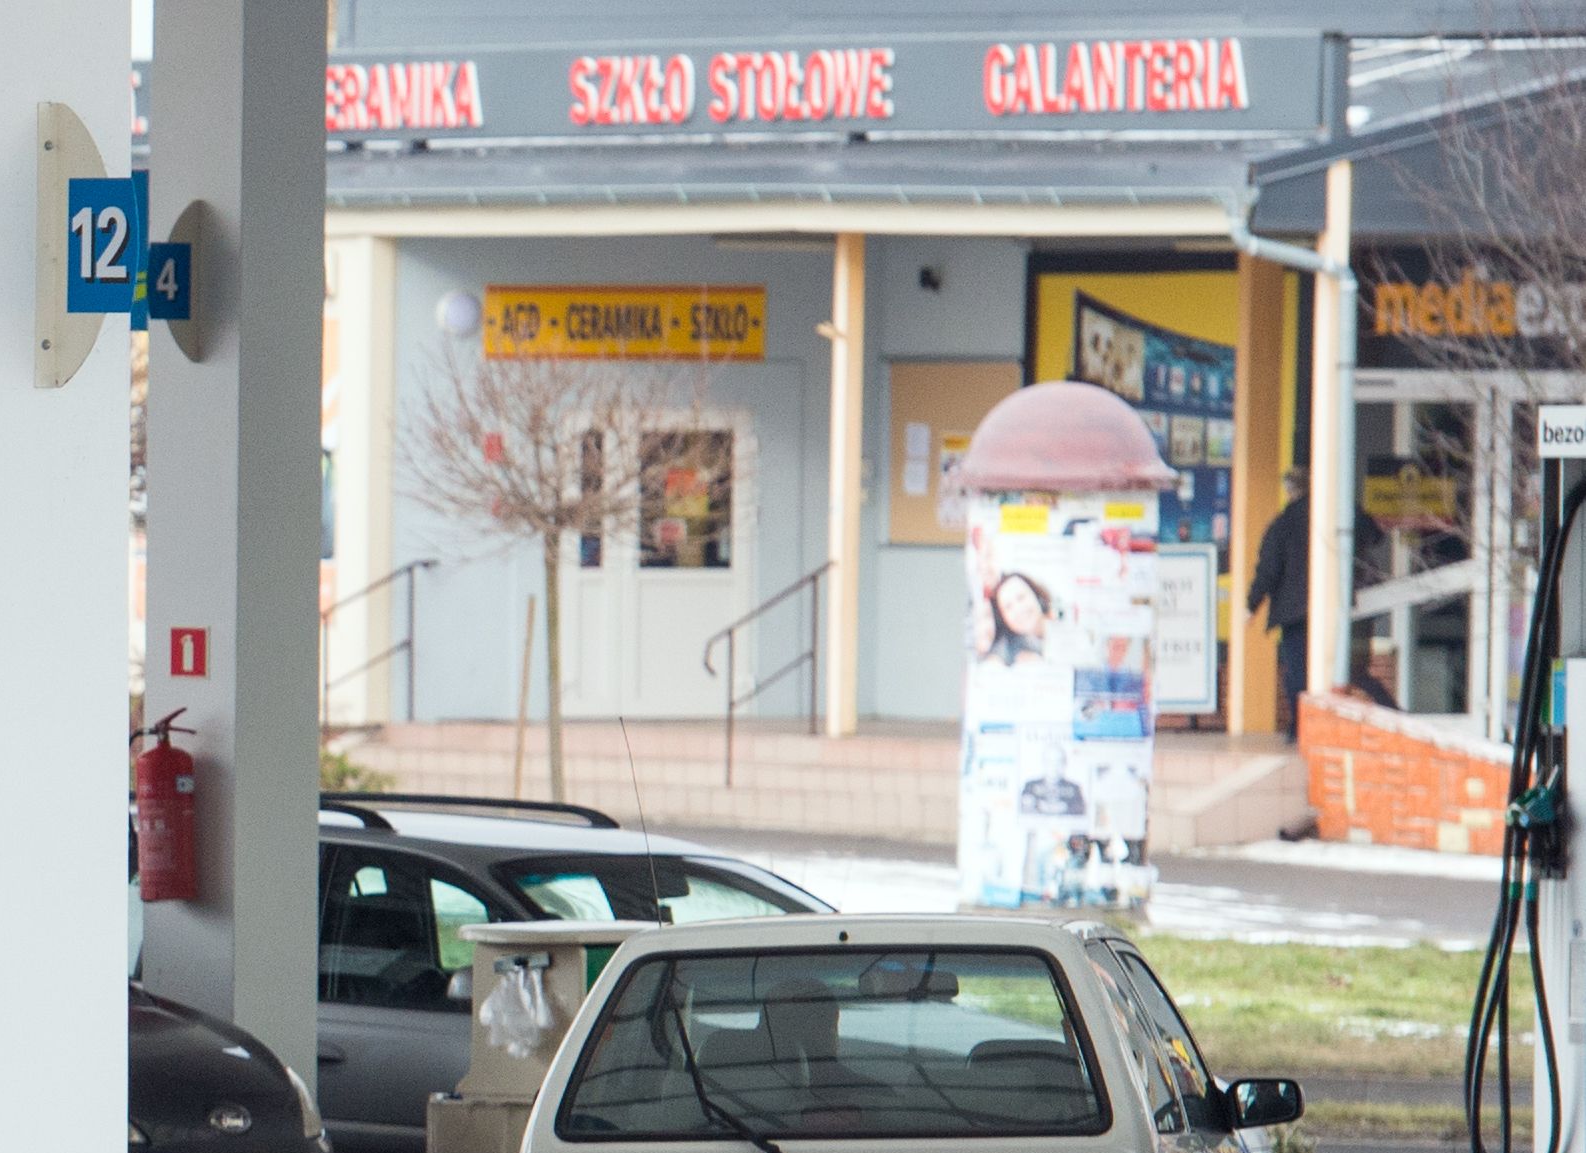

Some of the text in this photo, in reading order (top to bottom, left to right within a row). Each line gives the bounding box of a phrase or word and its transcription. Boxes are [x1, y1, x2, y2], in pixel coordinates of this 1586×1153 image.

[325, 60, 483, 131] ERAMIKA
[569, 47, 894, 126] SZKŁO STOŁOWE
[983, 37, 1249, 116] GALANTERIA
[72, 206, 128, 281] 12
[155, 258, 178, 300] 4
[566, 303, 663, 340] CERAMIKA
